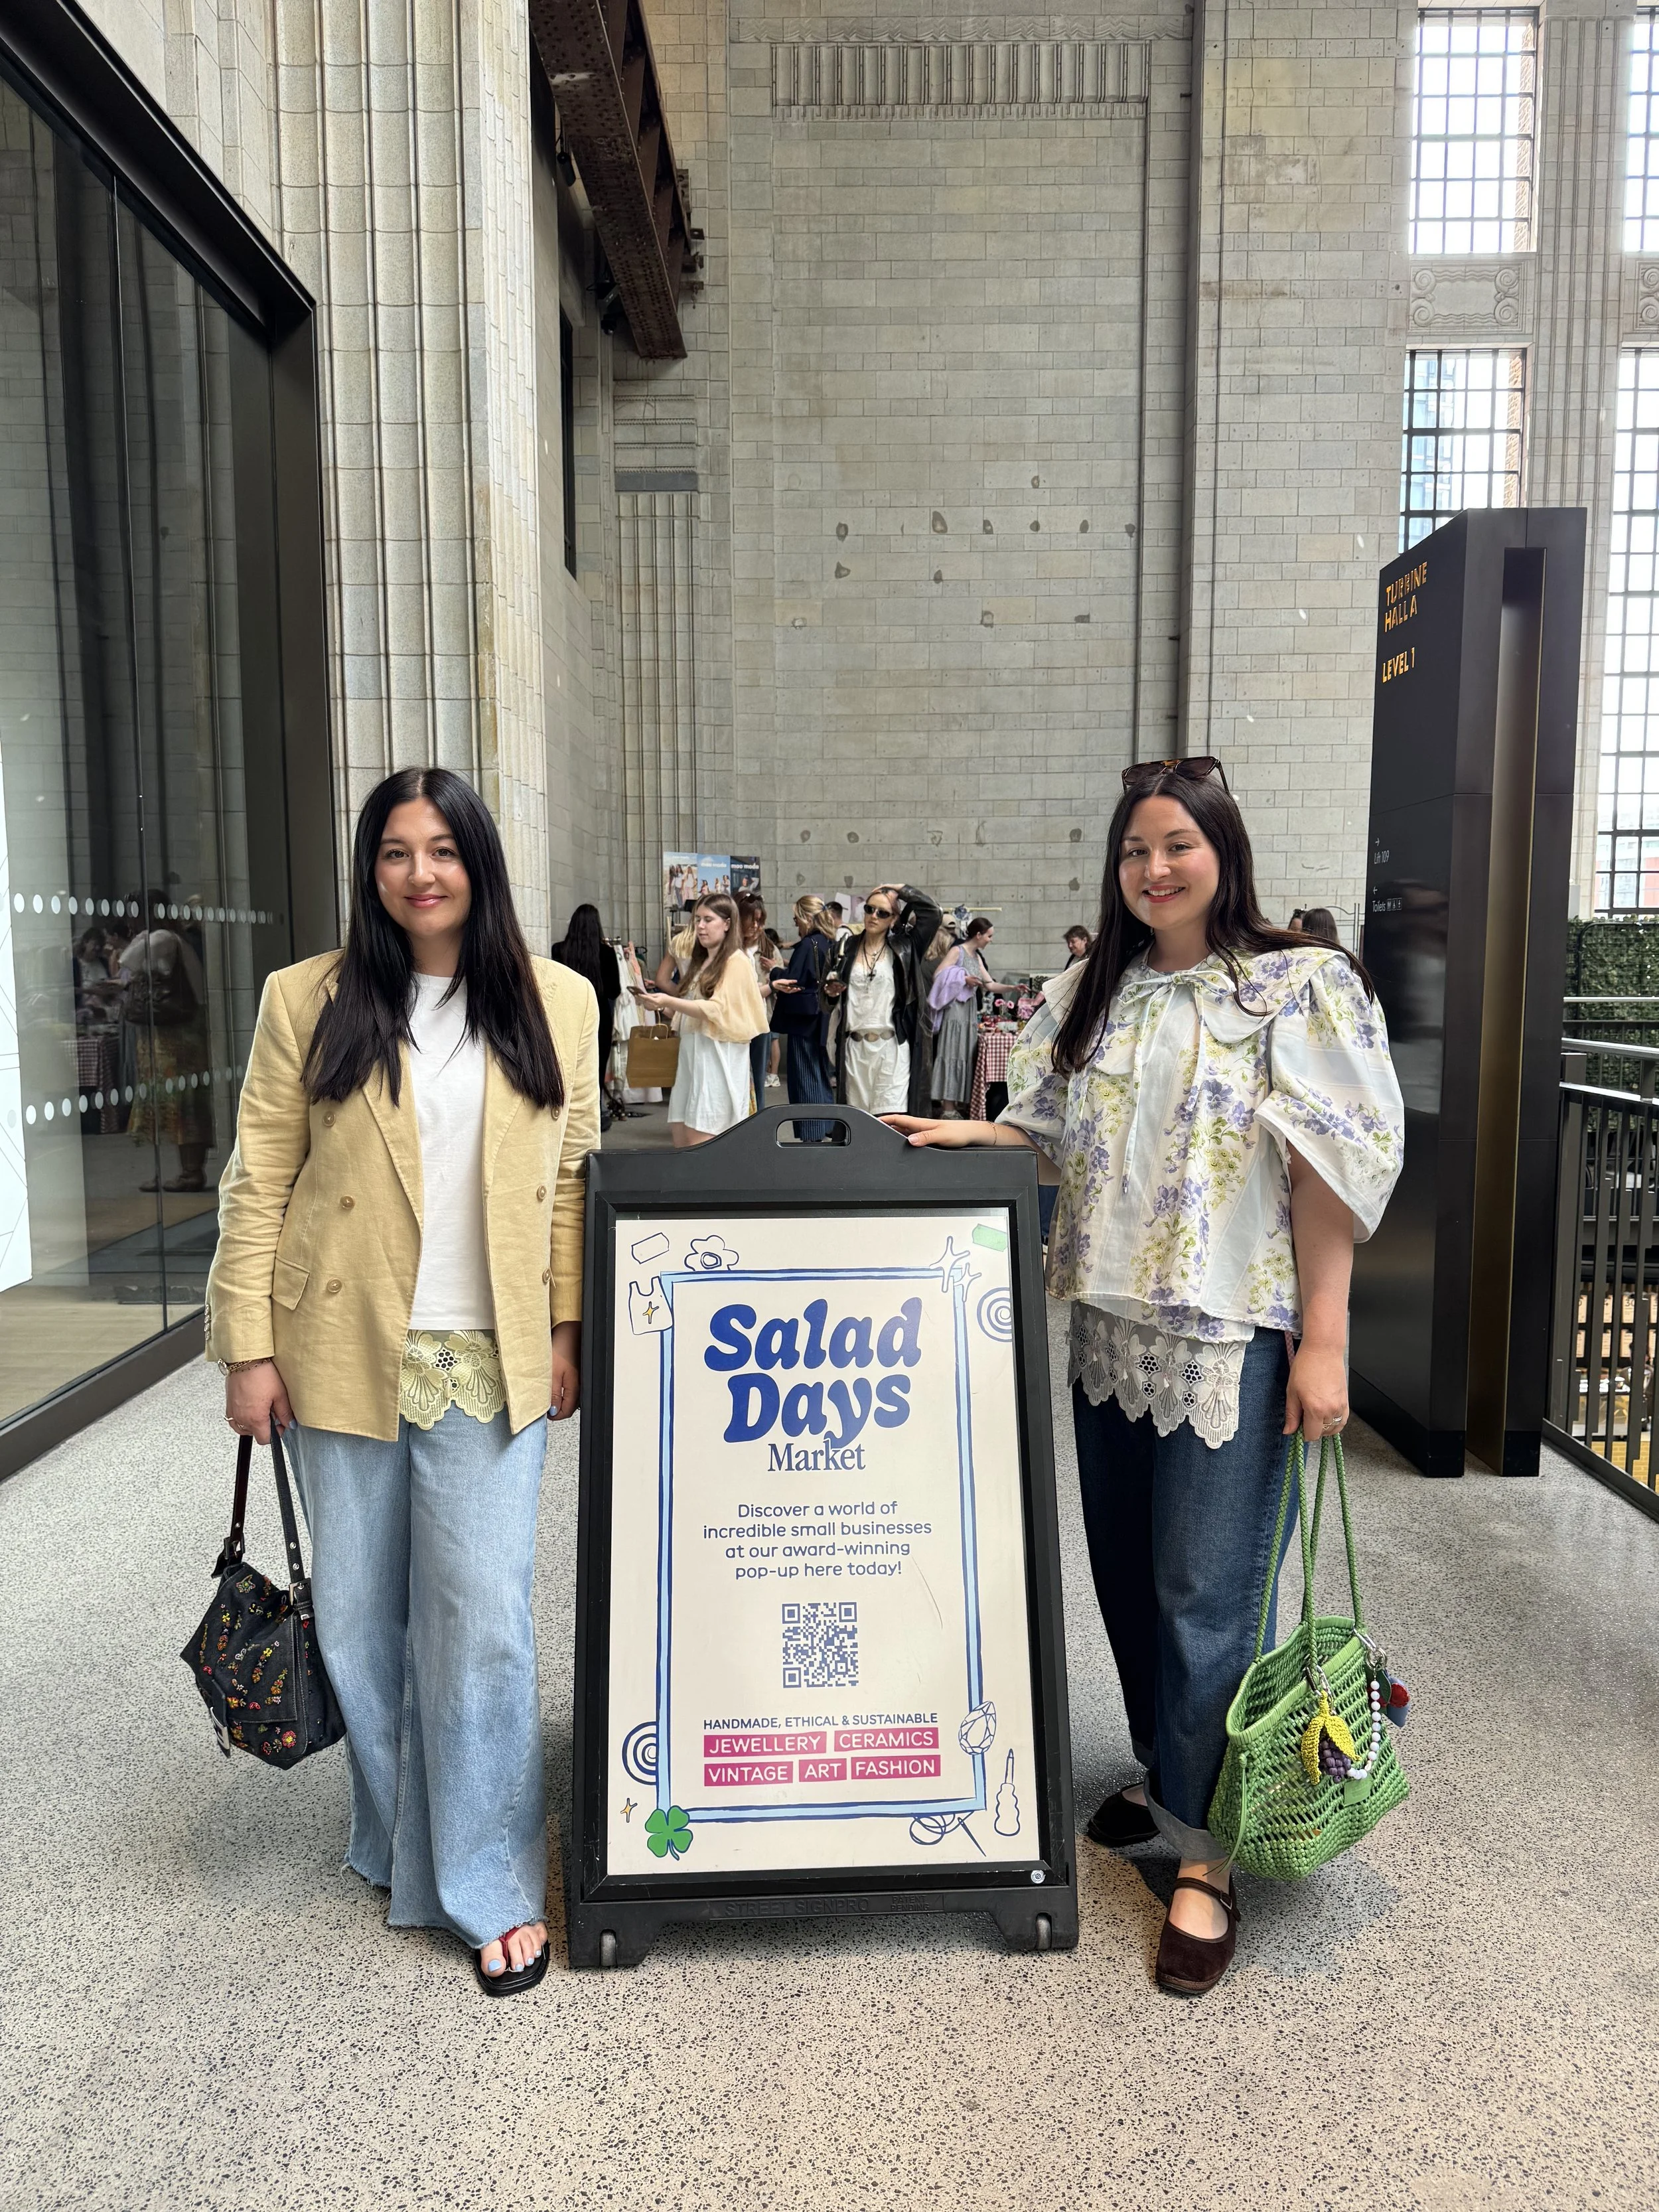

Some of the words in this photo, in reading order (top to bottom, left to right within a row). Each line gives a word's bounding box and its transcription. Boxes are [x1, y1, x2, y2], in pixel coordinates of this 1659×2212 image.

[1386, 561, 1427, 607] TURBINE
[1384, 601, 1408, 632] HALL
[1409, 595, 1417, 617] A
[1382, 650, 1409, 684] LEVEL
[1411, 647, 1415, 668] 1
[1372, 900, 1386, 913] Toilets
[704, 1297, 923, 1372] Salad
[724, 1372, 911, 1449] Days
[767, 1438, 865, 1471] Market
[738, 1504, 810, 1518] Discover
[814, 1505, 824, 1516] a
[828, 1502, 875, 1516] world
[880, 1501, 898, 1515] of
[703, 1523, 786, 1538] incredible
[791, 1522, 836, 1536] small
[841, 1521, 932, 1536] businesses
[725, 1544, 745, 1559] at
[749, 1544, 778, 1558] our
[782, 1541, 910, 1557] award-winning
[735, 1566, 799, 1580] pop-up
[804, 1562, 842, 1577] here
[847, 1561, 902, 1576] today!
[703, 1718, 782, 1730] HANDMADE,
[785, 1716, 838, 1728] ETHICAL
[841, 1715, 850, 1726] &
[852, 1713, 938, 1726] SUSTAINABLE
[709, 1735, 821, 1754] JEWELLERY
[839, 1731, 934, 1749] CERAMICS
[708, 1765, 788, 1783] VINTAGE
[804, 1763, 841, 1779] ART
[855, 1759, 935, 1776] FASHION
[725, 1900, 789, 1917] STREET
[890, 1903, 930, 1912] PENDING
[891, 1895, 928, 1904] PATENT
